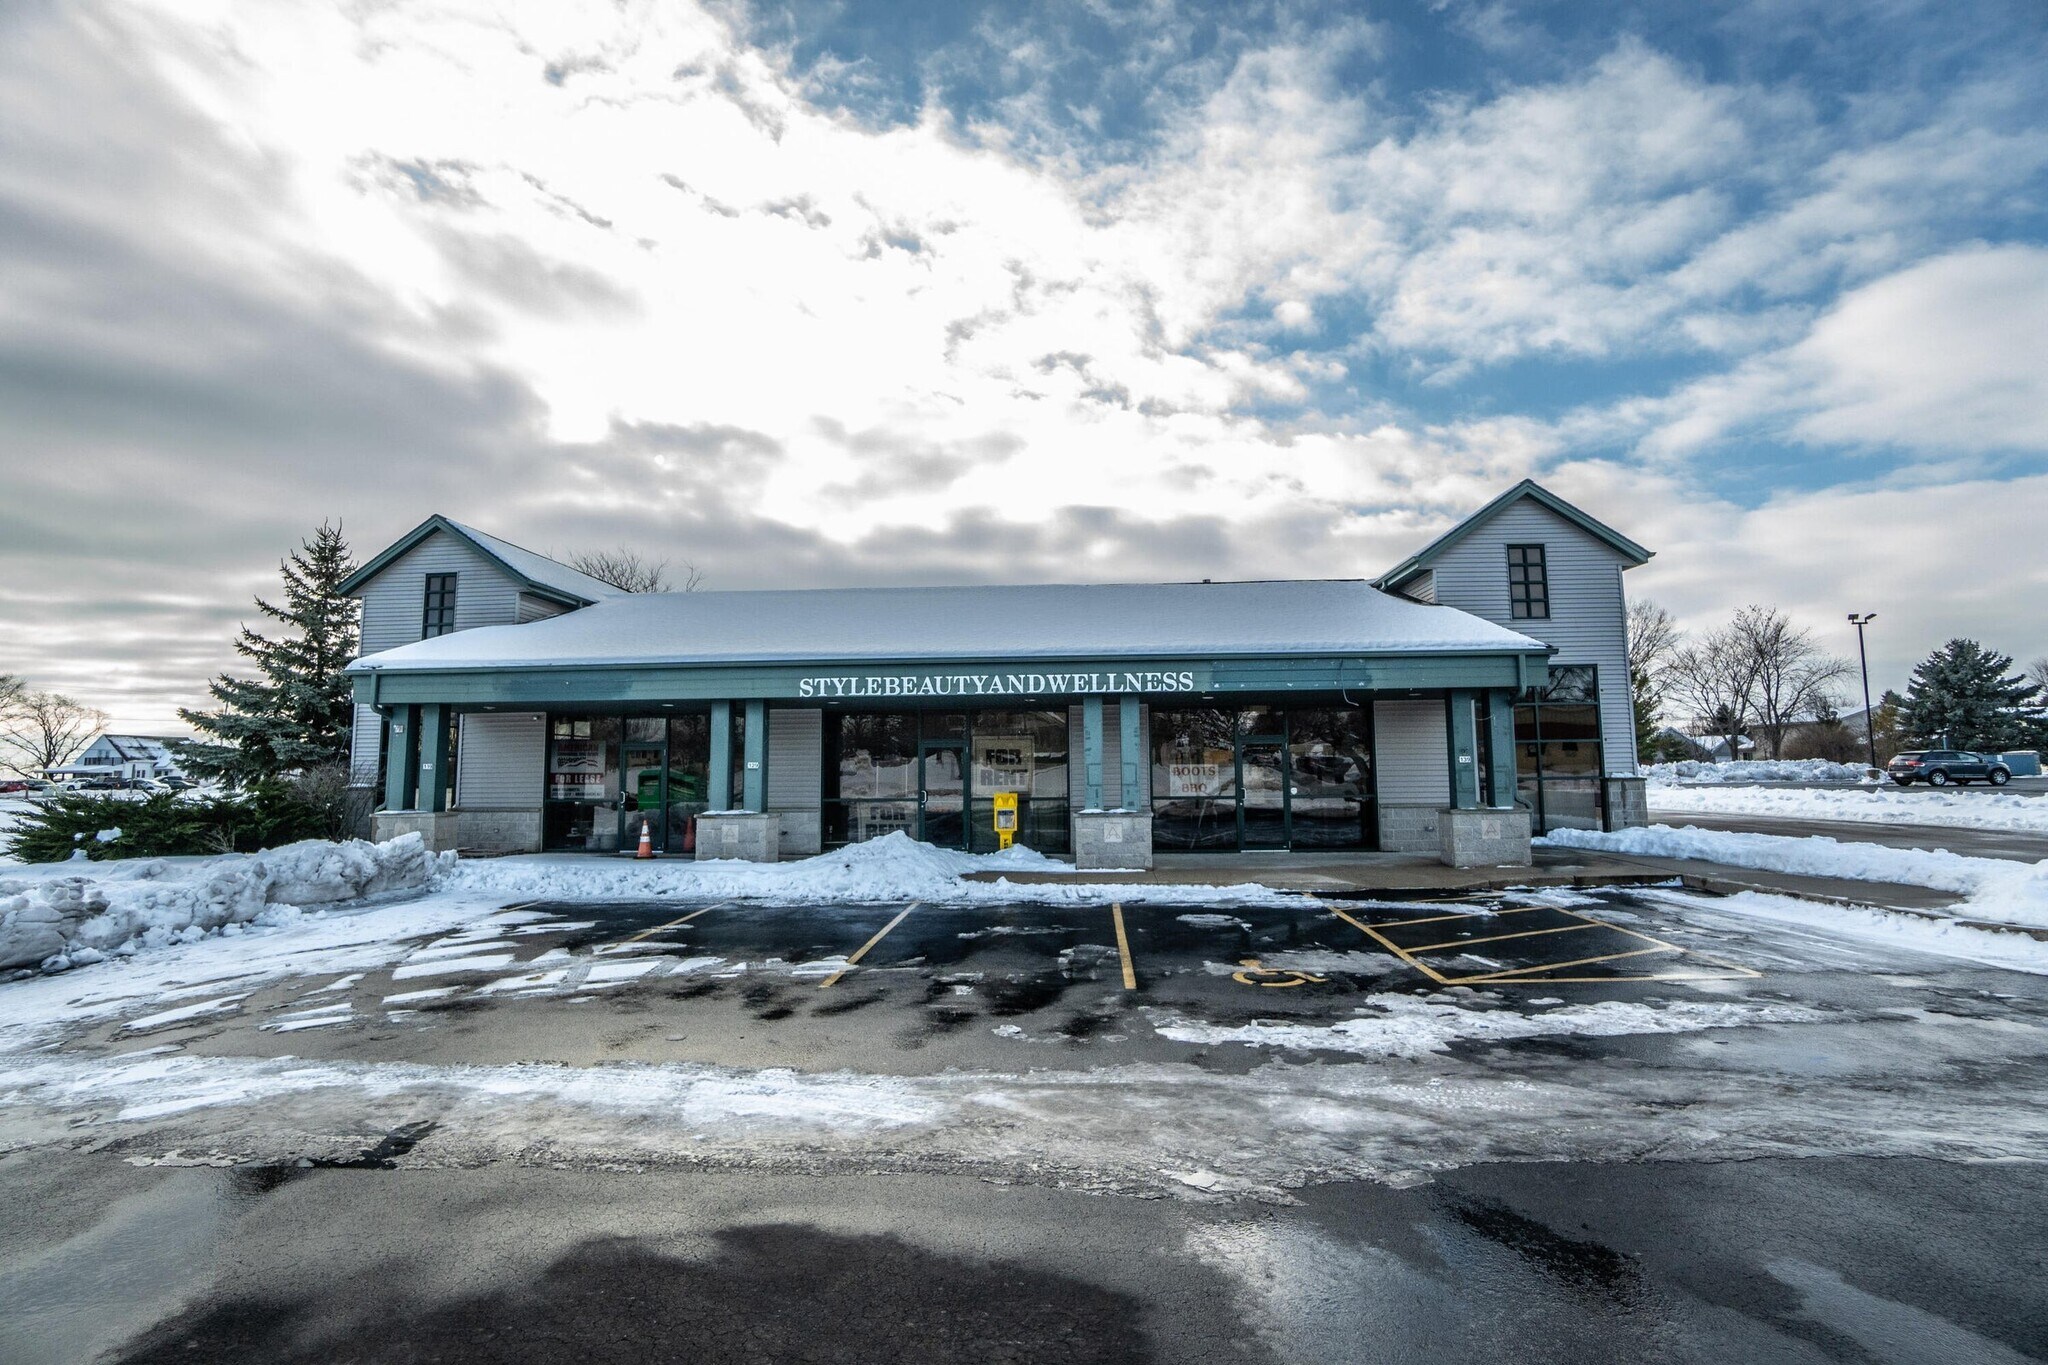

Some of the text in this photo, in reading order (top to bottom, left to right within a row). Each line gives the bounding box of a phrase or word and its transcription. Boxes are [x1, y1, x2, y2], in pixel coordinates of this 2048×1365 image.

[799, 671, 1194, 697] STYLEBEAUTYANDWELLNESS
[986, 749, 1021, 765] FOR
[981, 769, 1028, 785] RENT
[1172, 766, 1216, 777] BOOTS
[555, 774, 601, 784] FOR LEASE
[1182, 783, 1208, 793] BBQ
[870, 806, 906, 820] FOR
